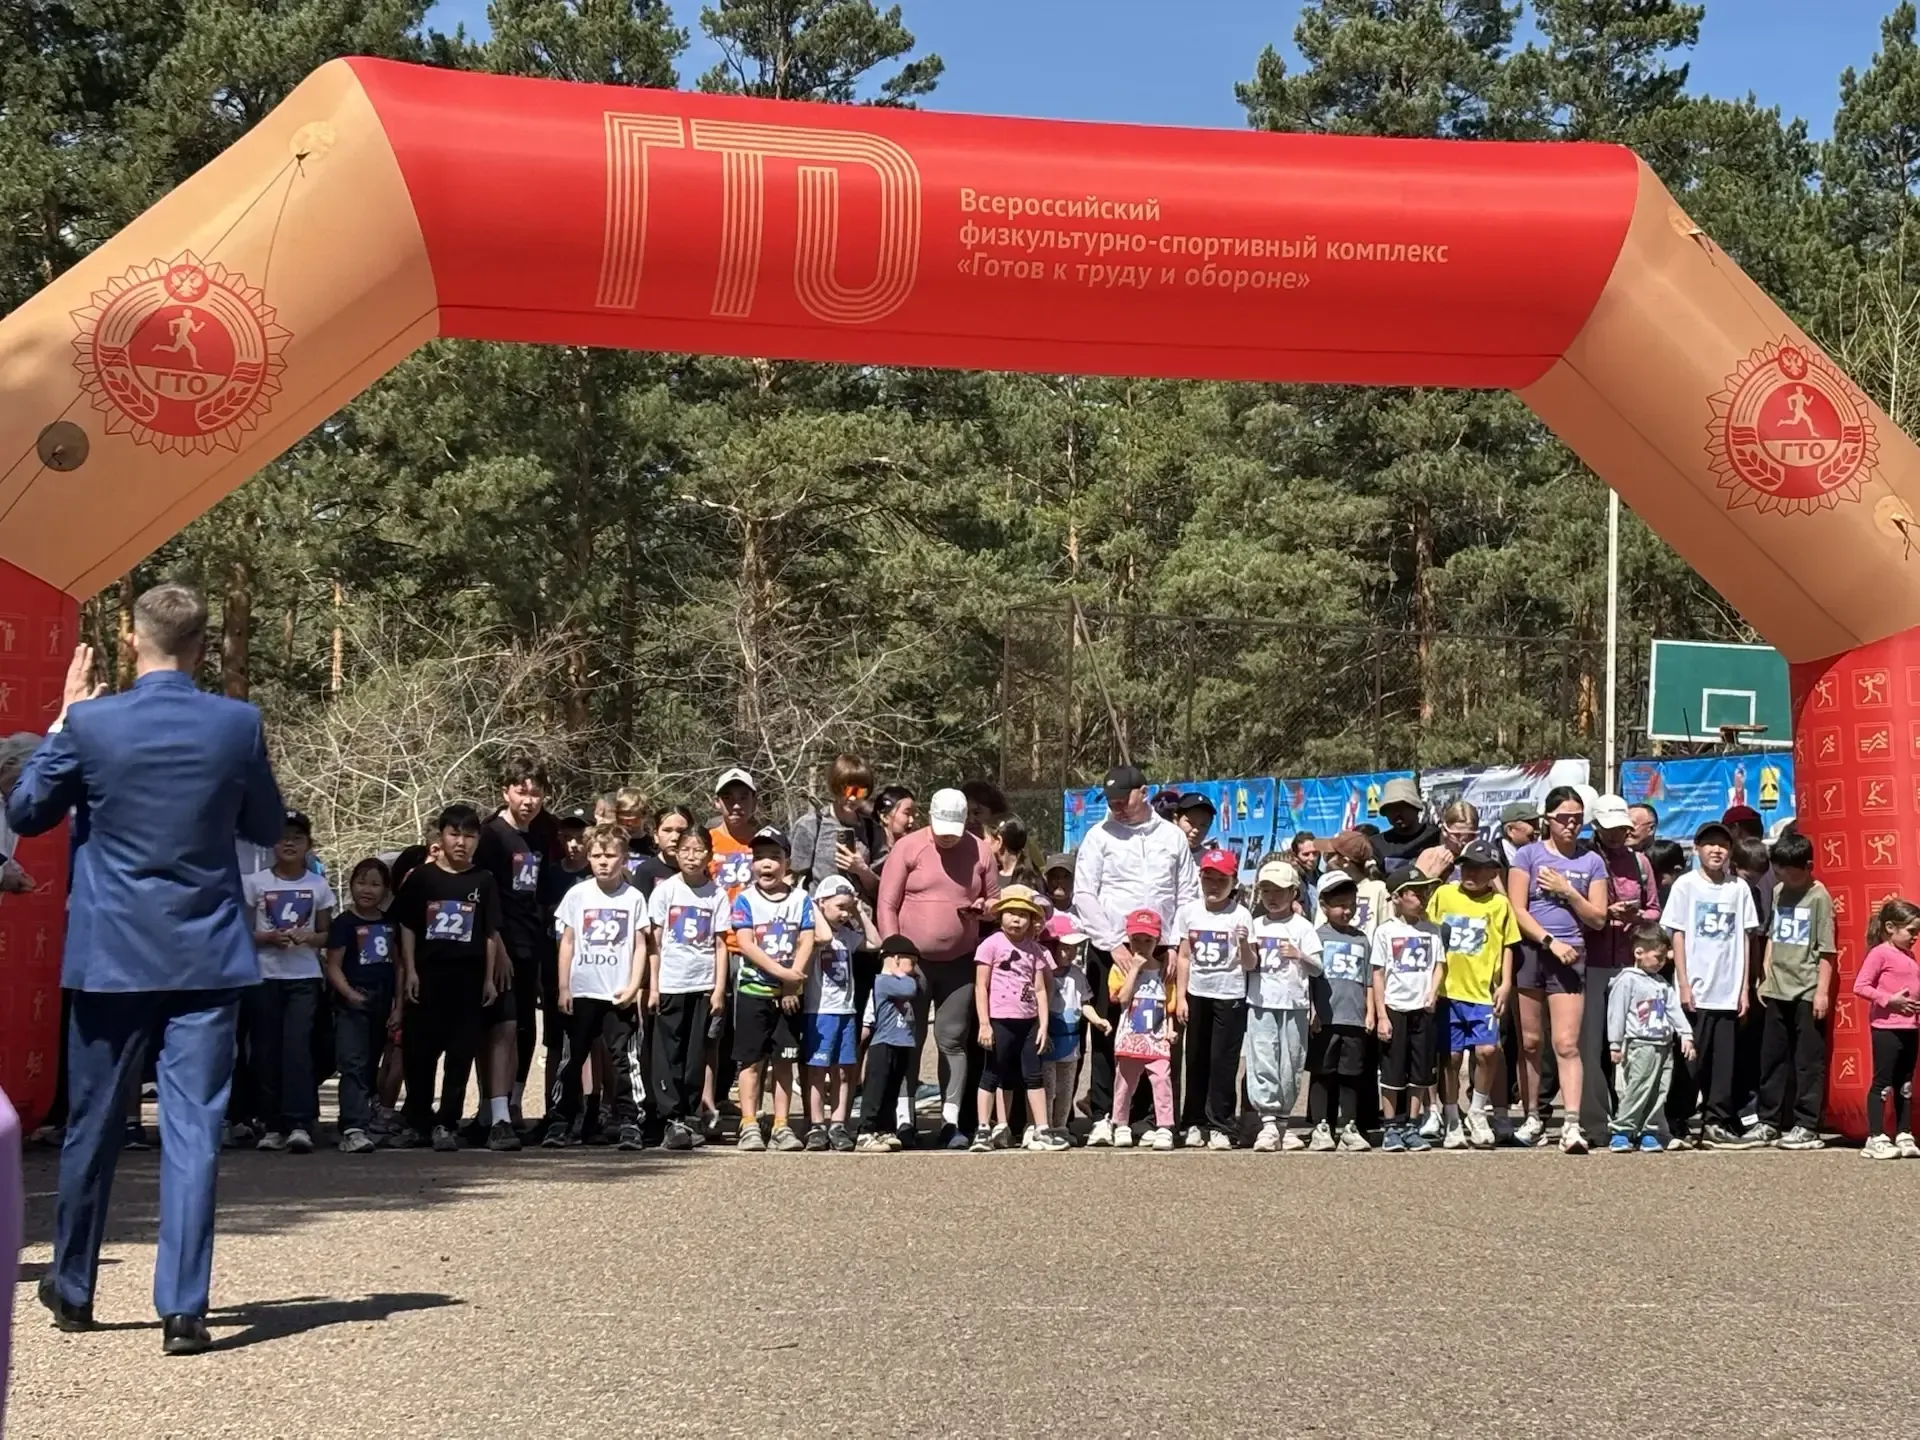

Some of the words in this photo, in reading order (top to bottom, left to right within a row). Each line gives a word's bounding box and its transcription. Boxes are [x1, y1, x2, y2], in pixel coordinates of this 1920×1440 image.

[960, 187, 1161, 221] Всероссийский
[596, 111, 921, 325] ГТО
[959, 219, 1318, 261] физкультурно-спортивный
[1326, 241, 1449, 264] комплекс
[957, 252, 1045, 279] «Готов
[1053, 262, 1068, 281] к
[1076, 263, 1152, 290] труду
[1160, 265, 1176, 285] и
[1184, 262, 1311, 293] обороне»
[154, 371, 208, 396] ГТО
[1780, 442, 1826, 461] ГТО
[722, 863, 751, 883] 36
[281, 902, 299, 922] 4
[435, 912, 464, 934] 22
[590, 920, 620, 941] 29
[683, 917, 698, 938] 5
[1780, 918, 1800, 940] 51
[374, 936, 388, 956] 8
[763, 933, 793, 955] 34
[1449, 926, 1476, 949] 52
[578, 953, 618, 966] JUDO
[1194, 941, 1220, 963] 25
[1258, 947, 1281, 968] 14
[1401, 947, 1427, 968] 42
[1331, 953, 1359, 974] 53
[1142, 1009, 1153, 1029] 1
